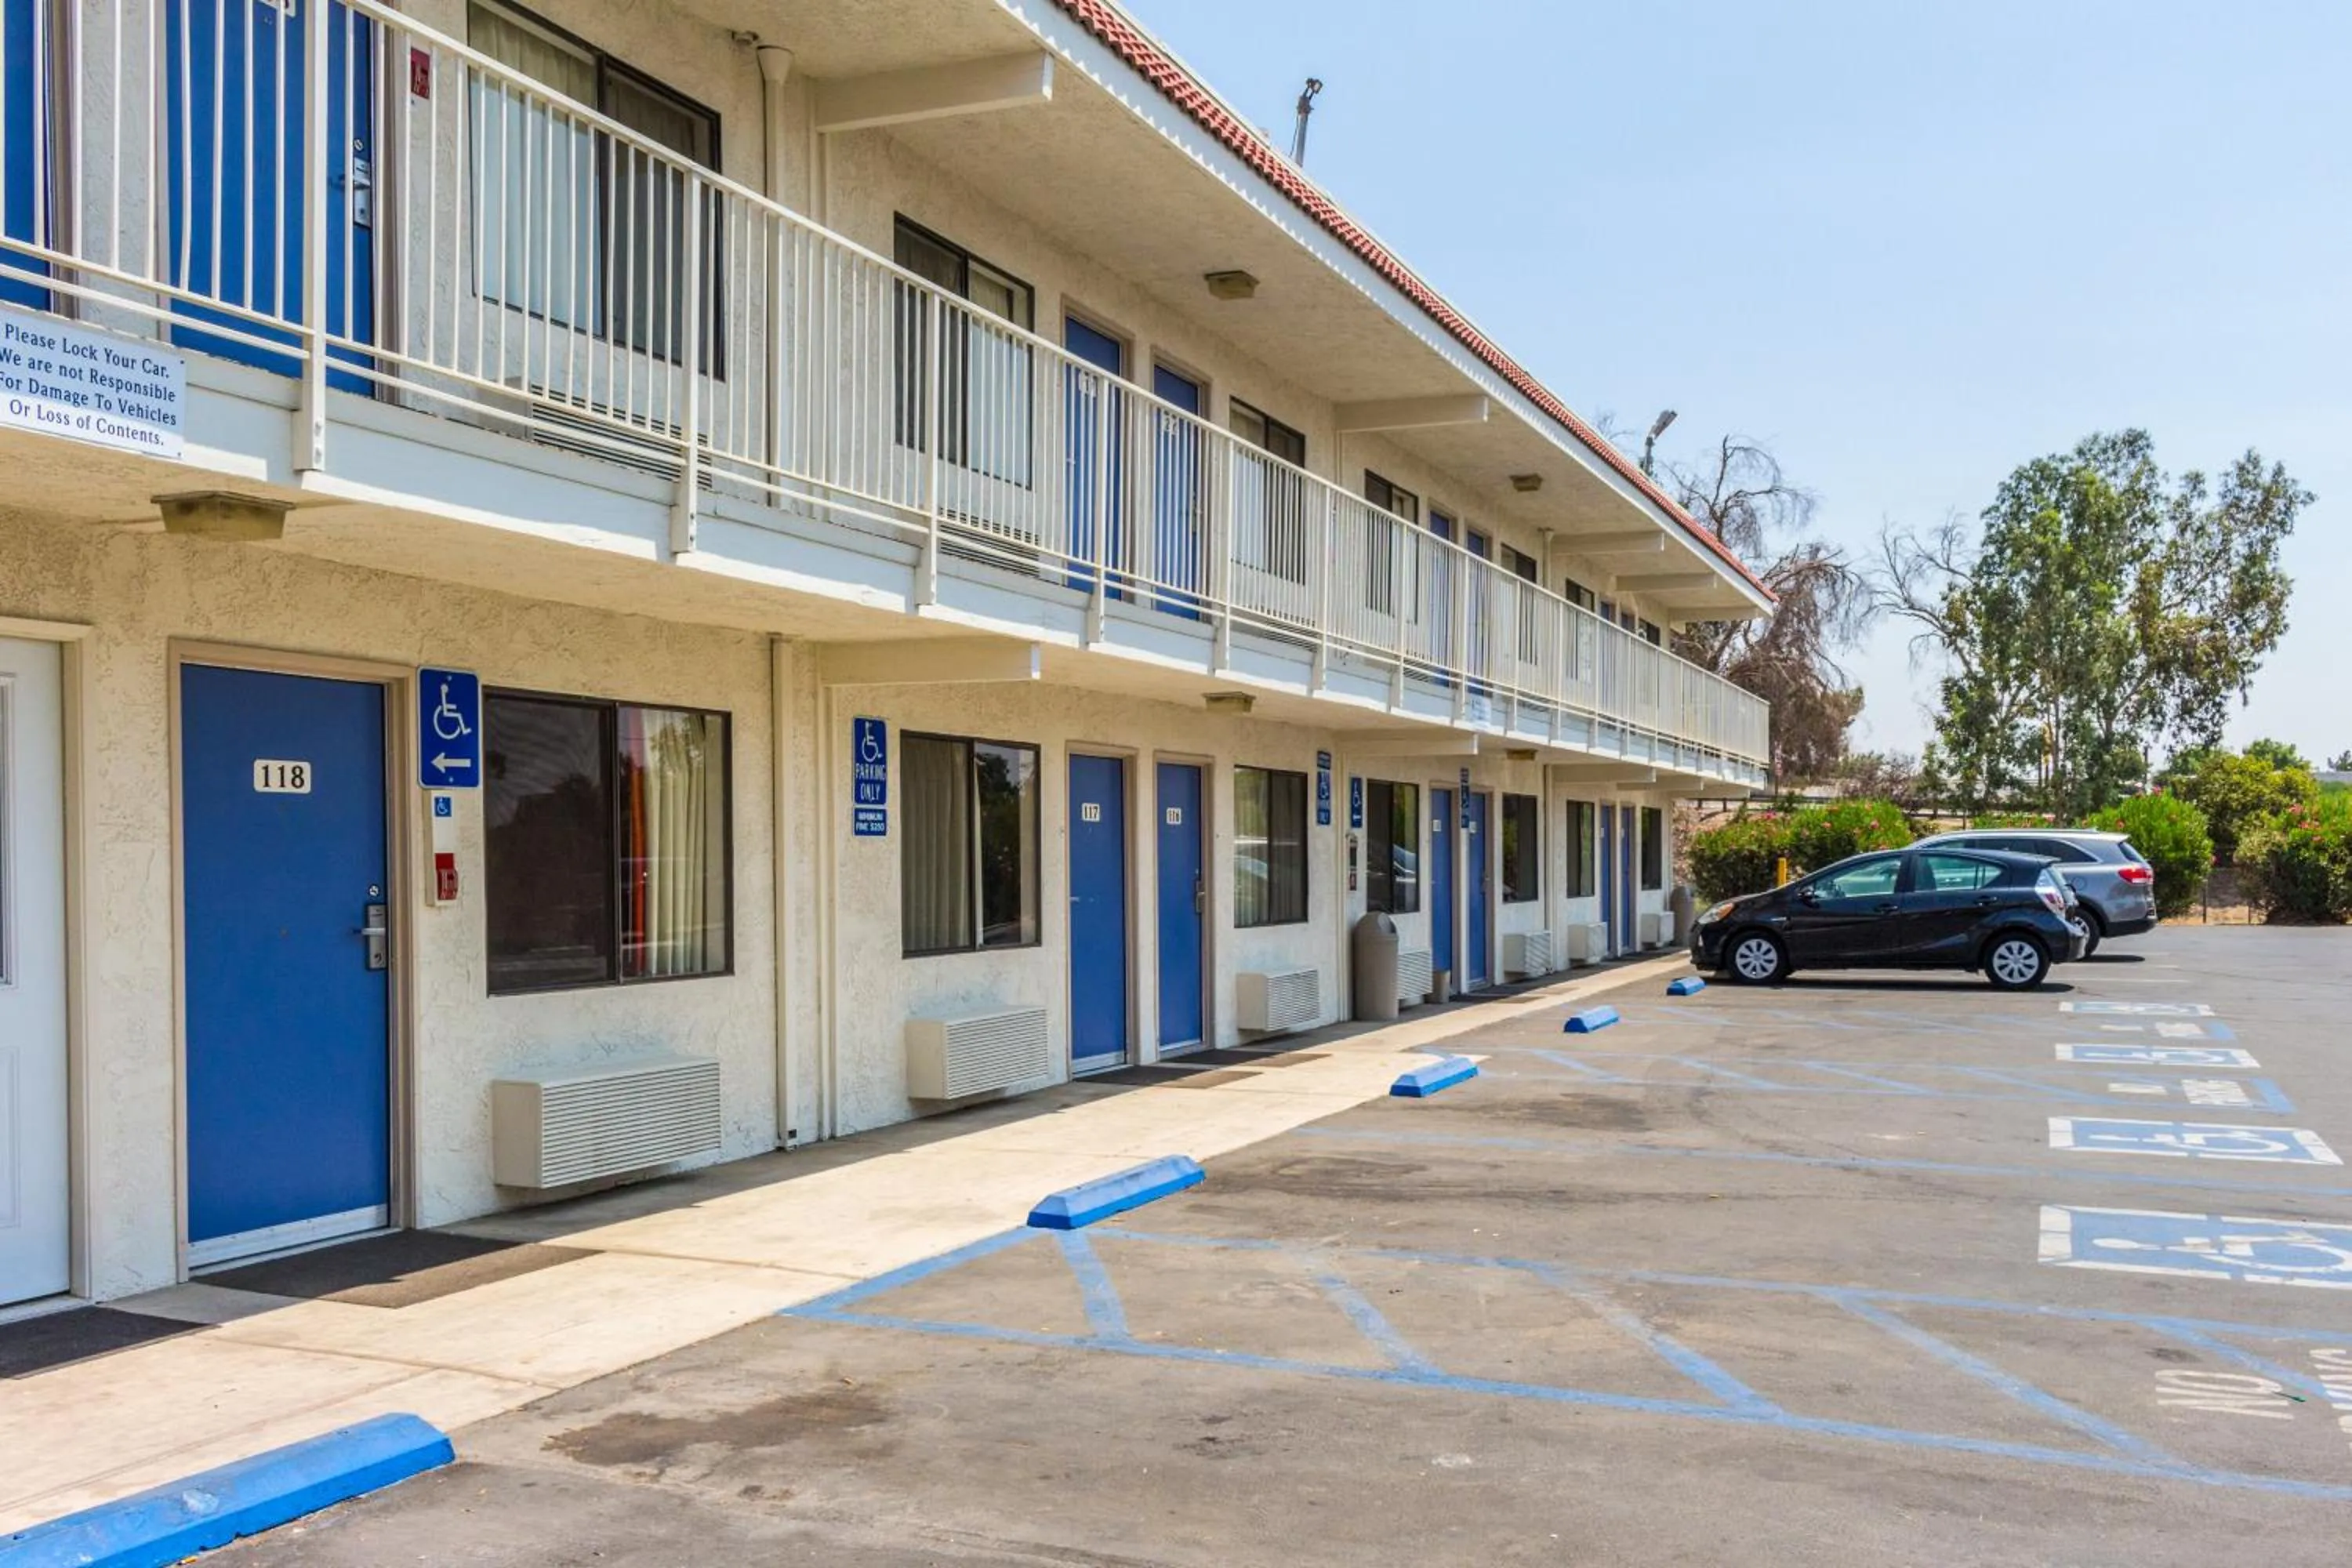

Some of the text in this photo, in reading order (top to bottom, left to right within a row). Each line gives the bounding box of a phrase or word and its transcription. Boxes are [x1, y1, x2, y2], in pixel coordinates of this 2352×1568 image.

[0, 347, 176, 402] We are not Responsible
[5, 323, 169, 379] Please Lock Your Car.
[9, 398, 164, 445] Or Loss of Contents.
[29, 378, 89, 407] Damage
[94, 393, 112, 411] To
[118, 397, 176, 426] Vehicles
[261, 764, 305, 789] 118
[860, 783, 880, 801] ONLY
[1083, 805, 1098, 819] 117
